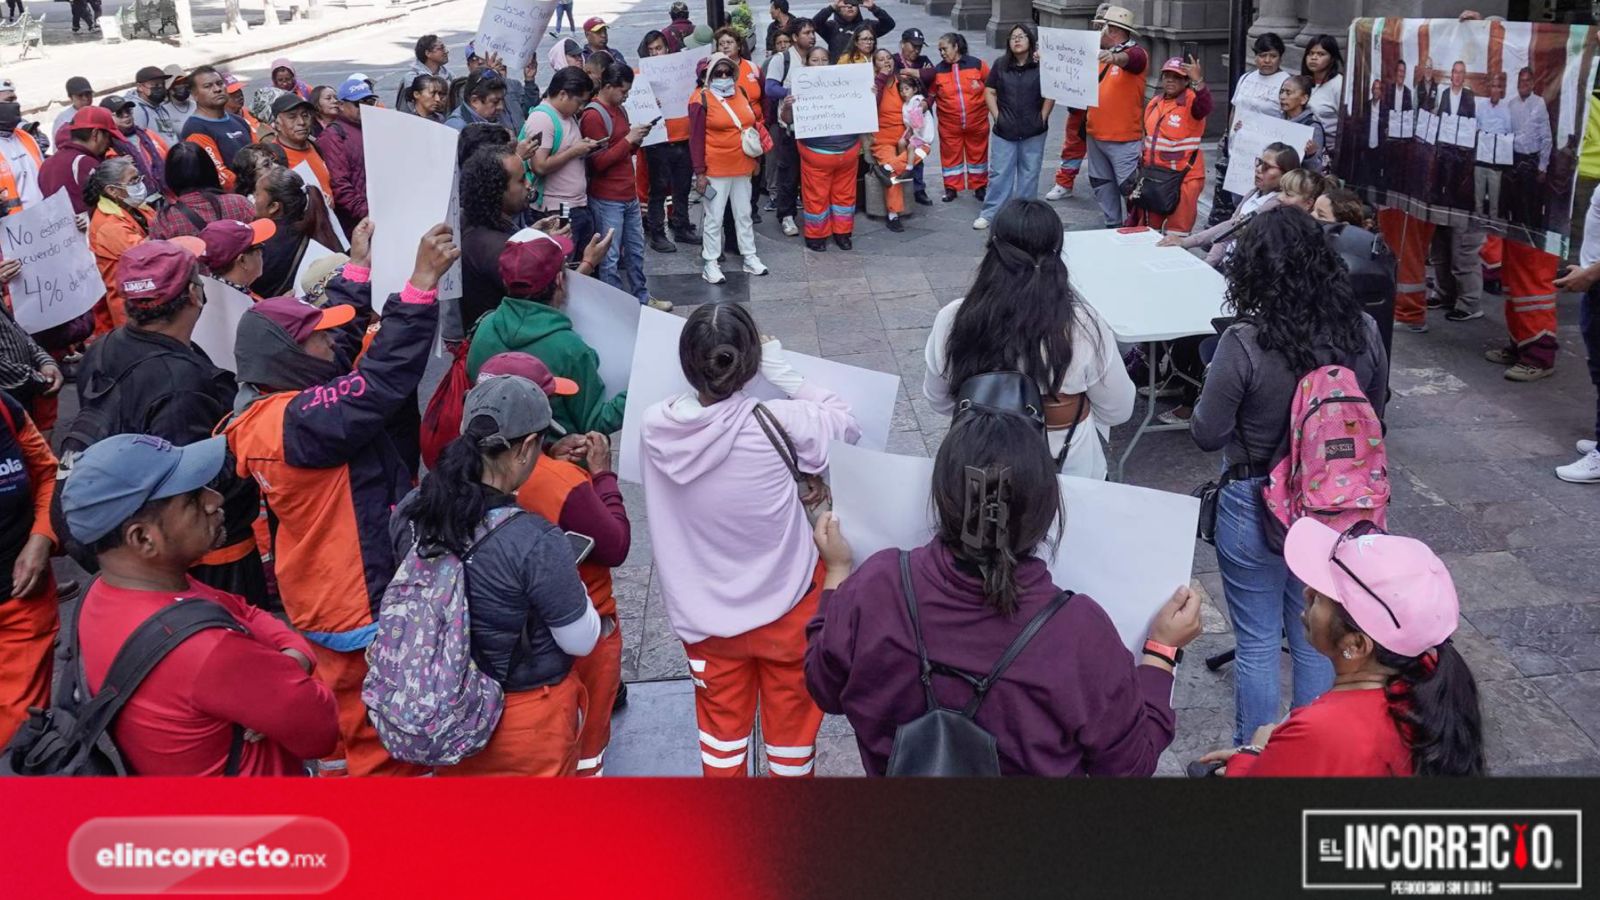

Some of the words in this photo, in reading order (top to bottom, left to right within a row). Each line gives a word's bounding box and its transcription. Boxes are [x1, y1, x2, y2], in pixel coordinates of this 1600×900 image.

[1042, 34, 1055, 51] No
[1065, 64, 1081, 81] 4%
[5, 224, 34, 251] No
[23, 275, 64, 313] 4%
